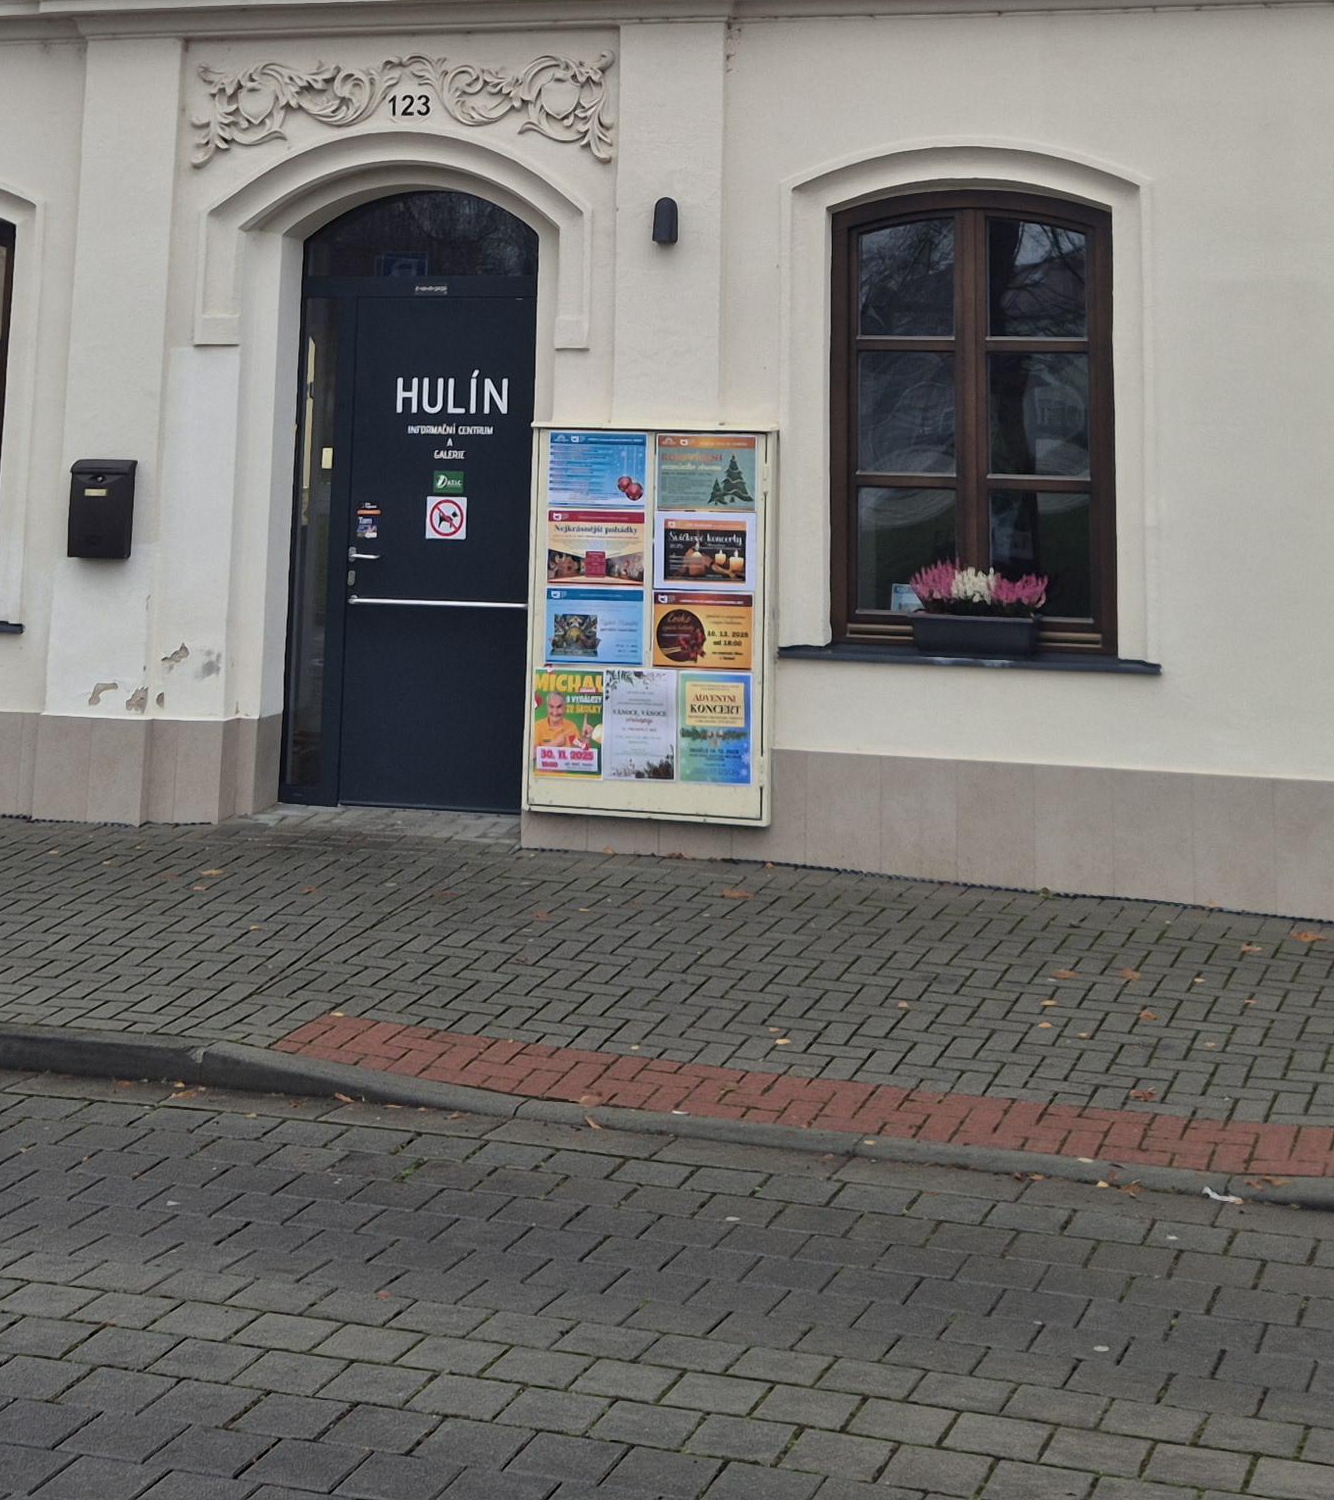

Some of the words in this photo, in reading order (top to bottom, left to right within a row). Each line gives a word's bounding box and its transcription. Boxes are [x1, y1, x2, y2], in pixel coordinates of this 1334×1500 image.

[388, 94, 430, 116] 123
[396, 369, 508, 414] HULÍN
[408, 423, 456, 435] INFORMAČNÍ
[458, 426, 493, 435] CENTRUM
[434, 449, 466, 460] GALERIE
[554, 524, 603, 534] Nejkrásnější
[605, 525, 637, 536] pohádky
[707, 533, 742, 546] koncerty
[535, 673, 603, 693] MICHAL
[690, 703, 742, 715] KONCERT
[540, 749, 555, 759] 30.
[570, 750, 594, 761] 2025
